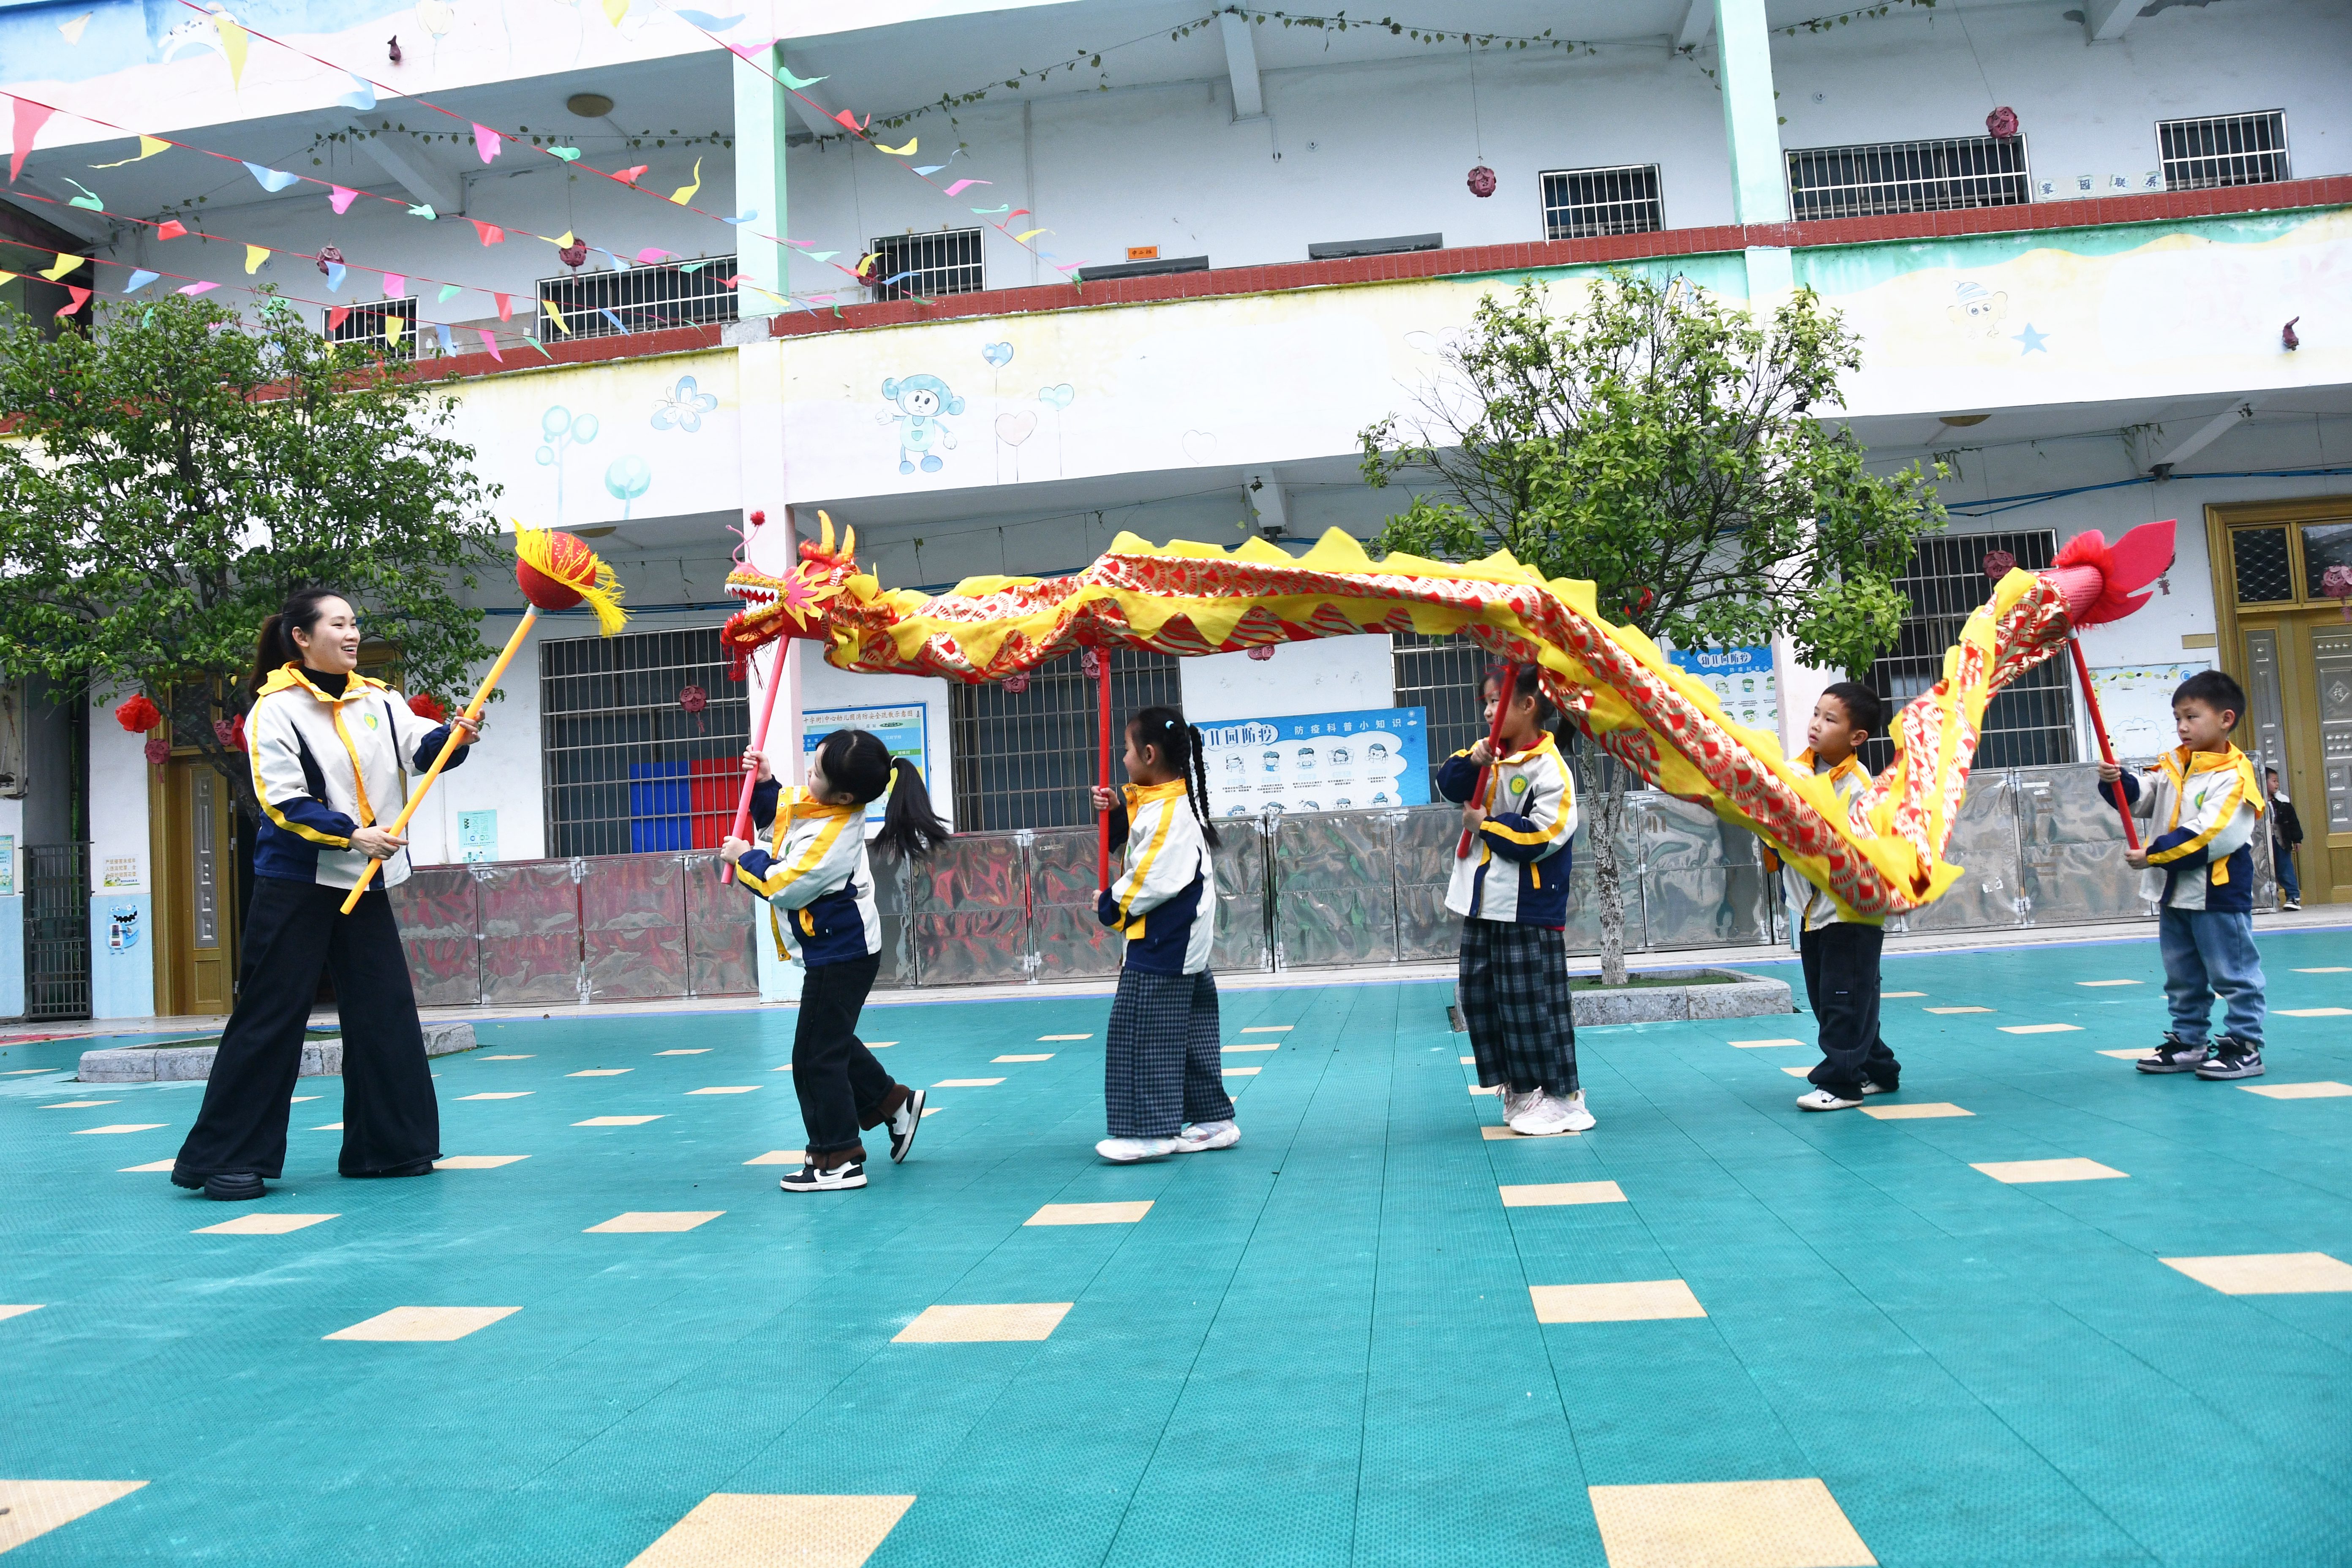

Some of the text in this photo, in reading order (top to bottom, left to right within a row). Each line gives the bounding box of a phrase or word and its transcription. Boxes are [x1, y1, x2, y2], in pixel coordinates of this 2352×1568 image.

[1294, 718, 1402, 735] 防疫科普小知识
